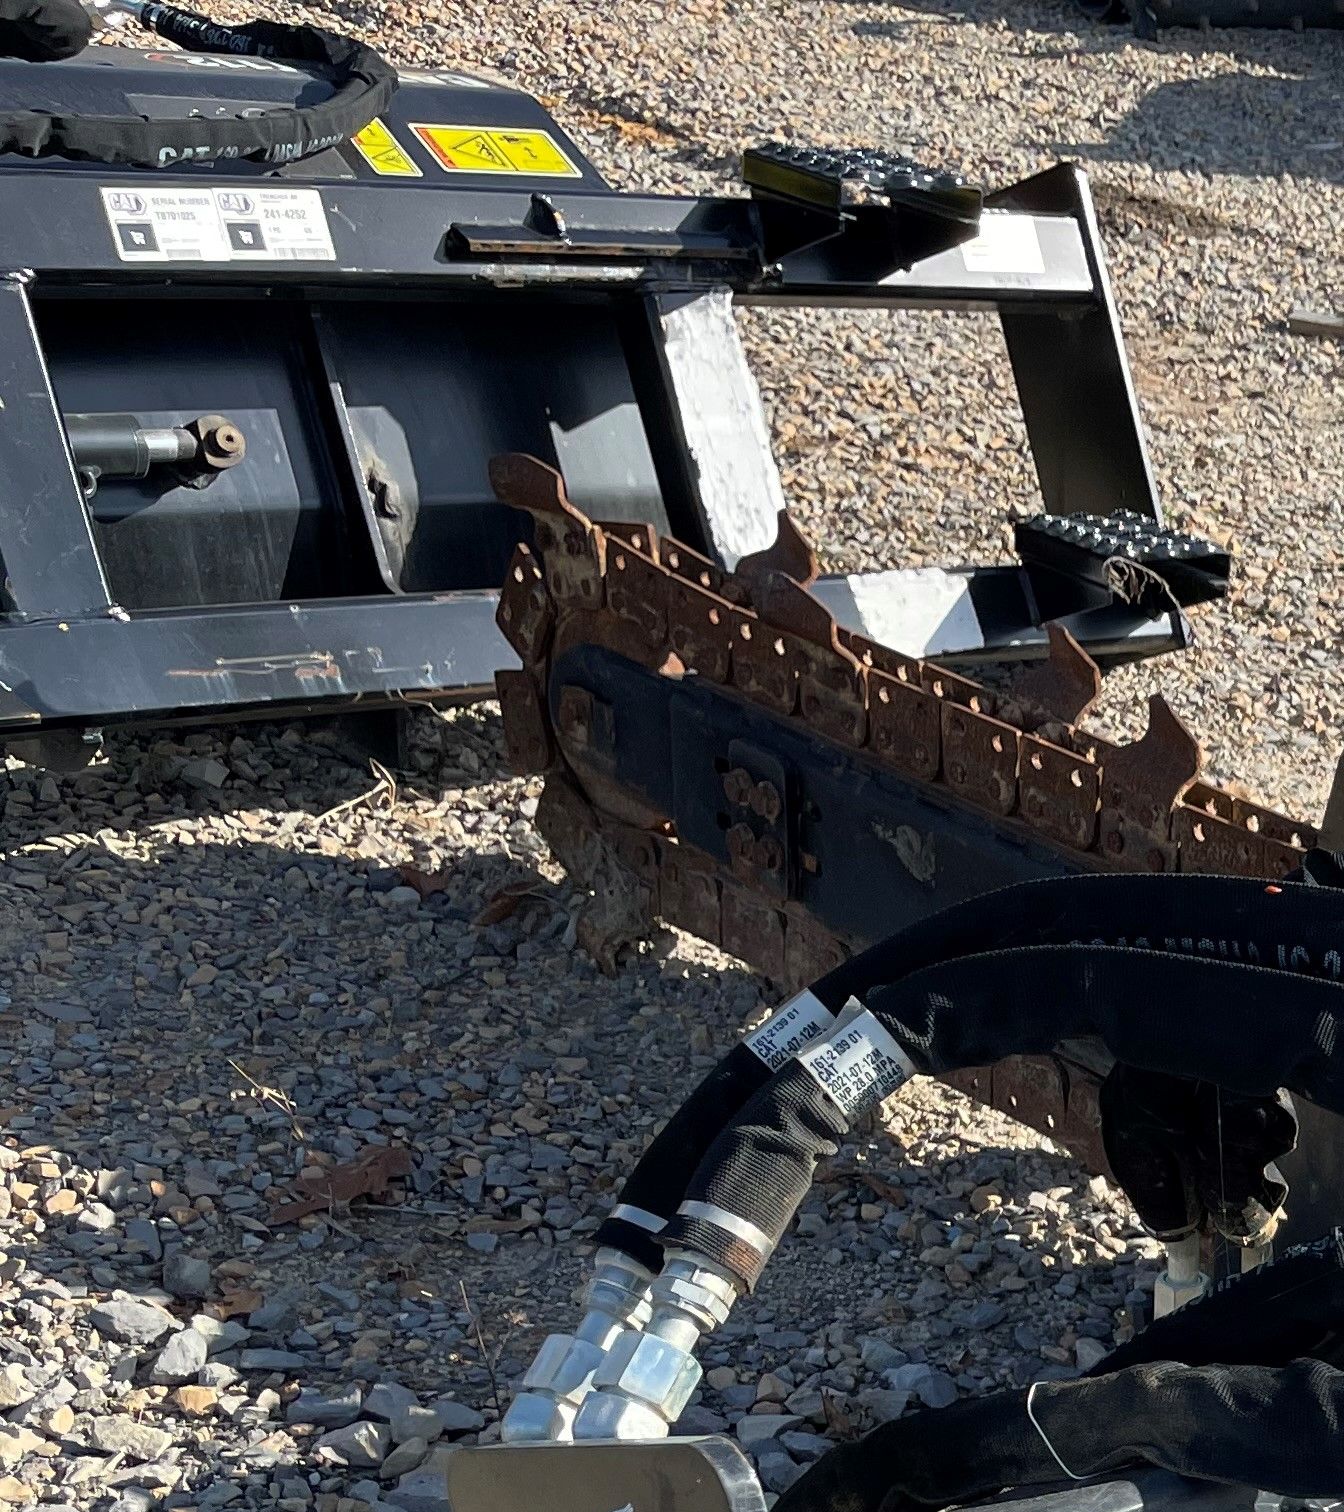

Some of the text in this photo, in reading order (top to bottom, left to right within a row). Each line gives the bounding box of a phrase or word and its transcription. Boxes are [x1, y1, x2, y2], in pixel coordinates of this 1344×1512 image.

[756, 1038, 778, 1059] CAT
[809, 1028, 863, 1072] 161-2139 01
[827, 1047, 884, 1094] 2021-07-12M
[816, 1061, 840, 1084] CAT
[835, 1085, 854, 1104] WP
[871, 1053, 896, 1076] MPA
